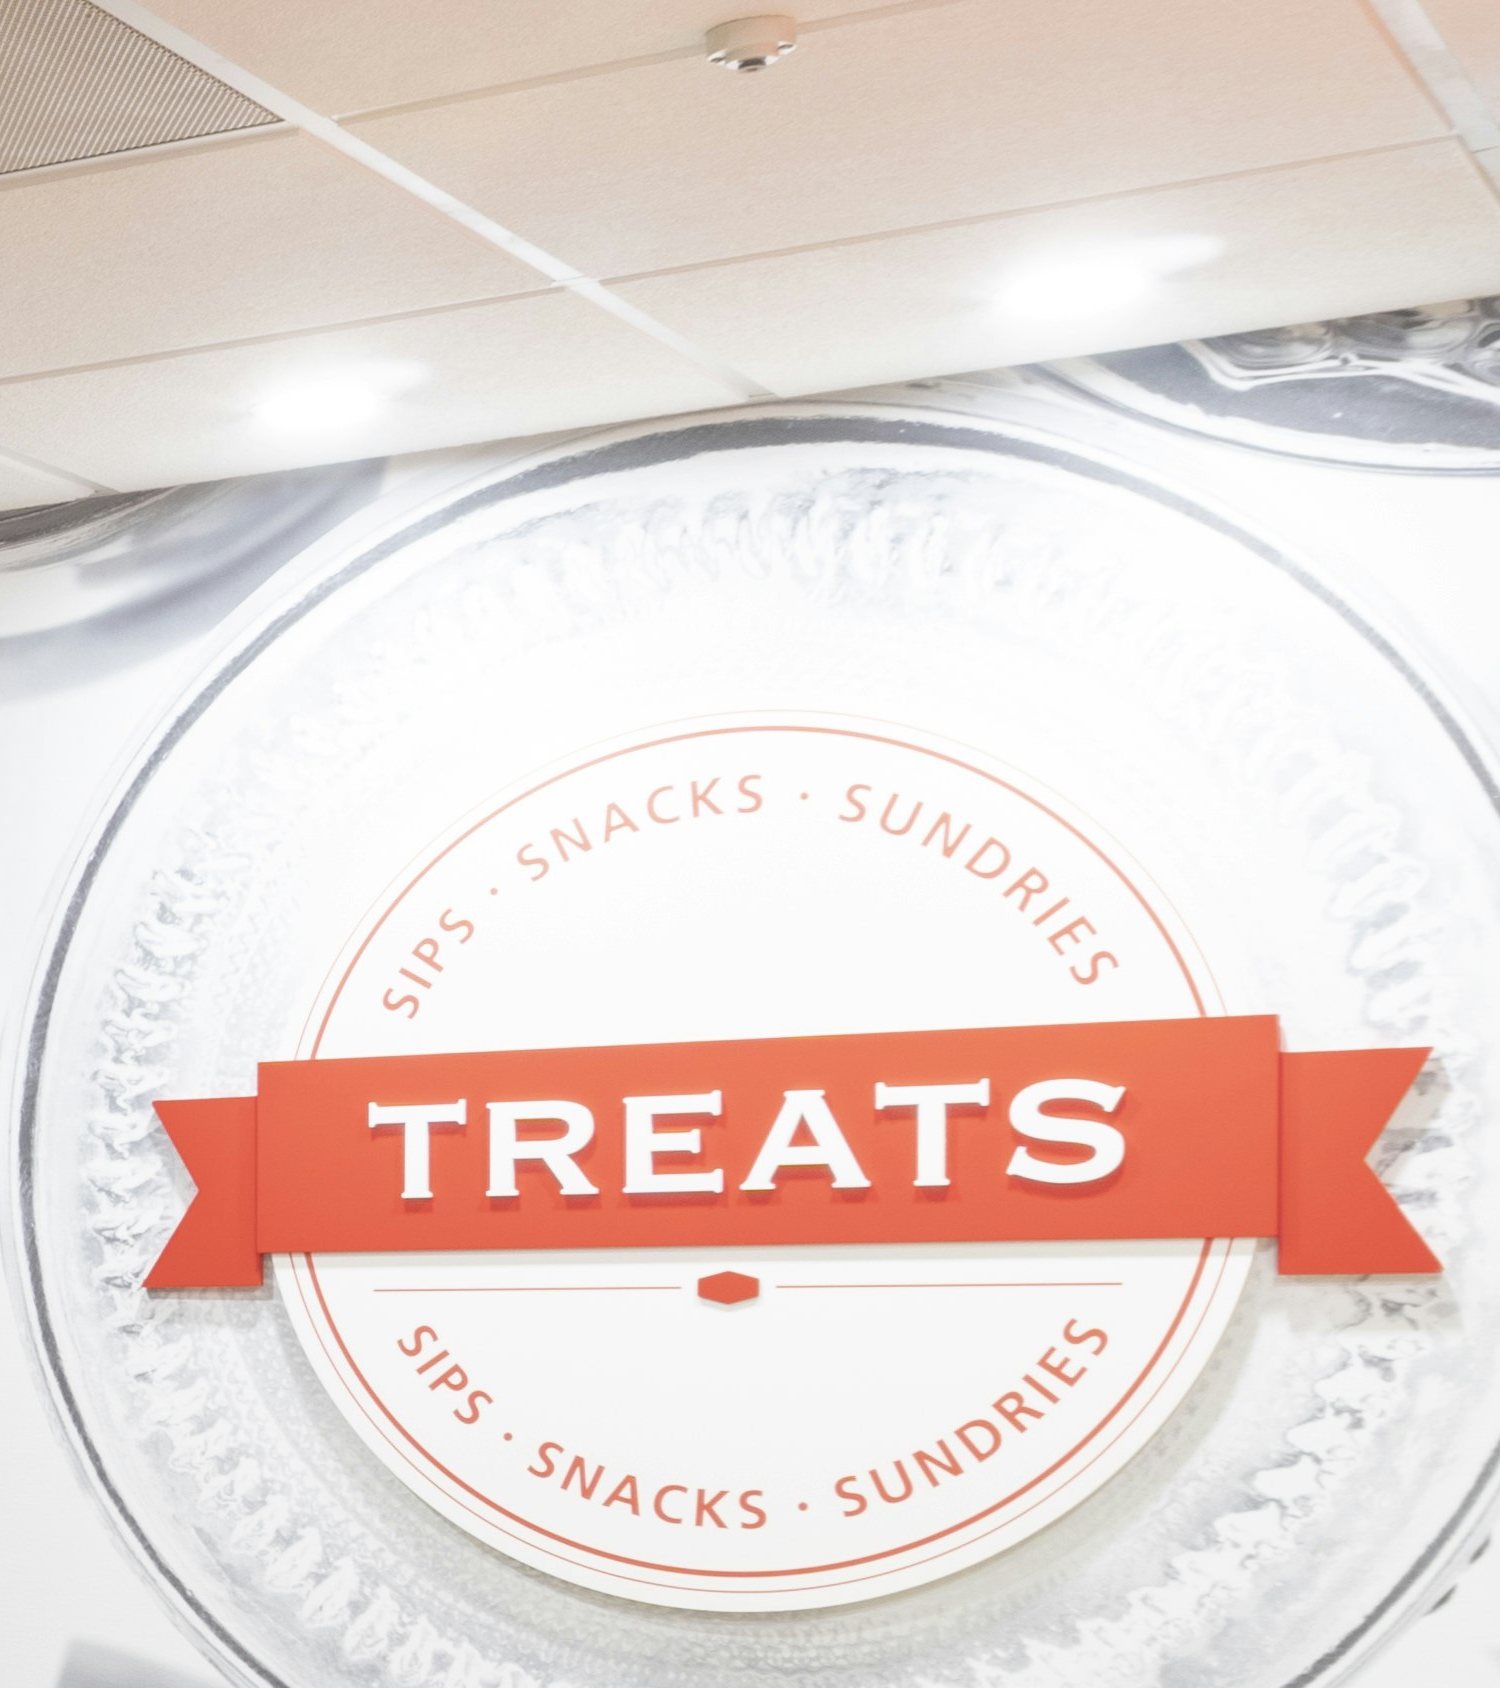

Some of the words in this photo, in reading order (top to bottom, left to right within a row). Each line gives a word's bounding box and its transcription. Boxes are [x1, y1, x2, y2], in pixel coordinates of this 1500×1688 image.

[382, 908, 475, 1020] SIPS
[516, 773, 764, 883] SNACKS
[838, 783, 1120, 988] SUNDRIES
[368, 1077, 1127, 1200] TREATS
[396, 1325, 493, 1426] SIPS
[527, 1440, 767, 1531] SNACKS
[833, 1318, 1107, 1518] SUNDRIES
